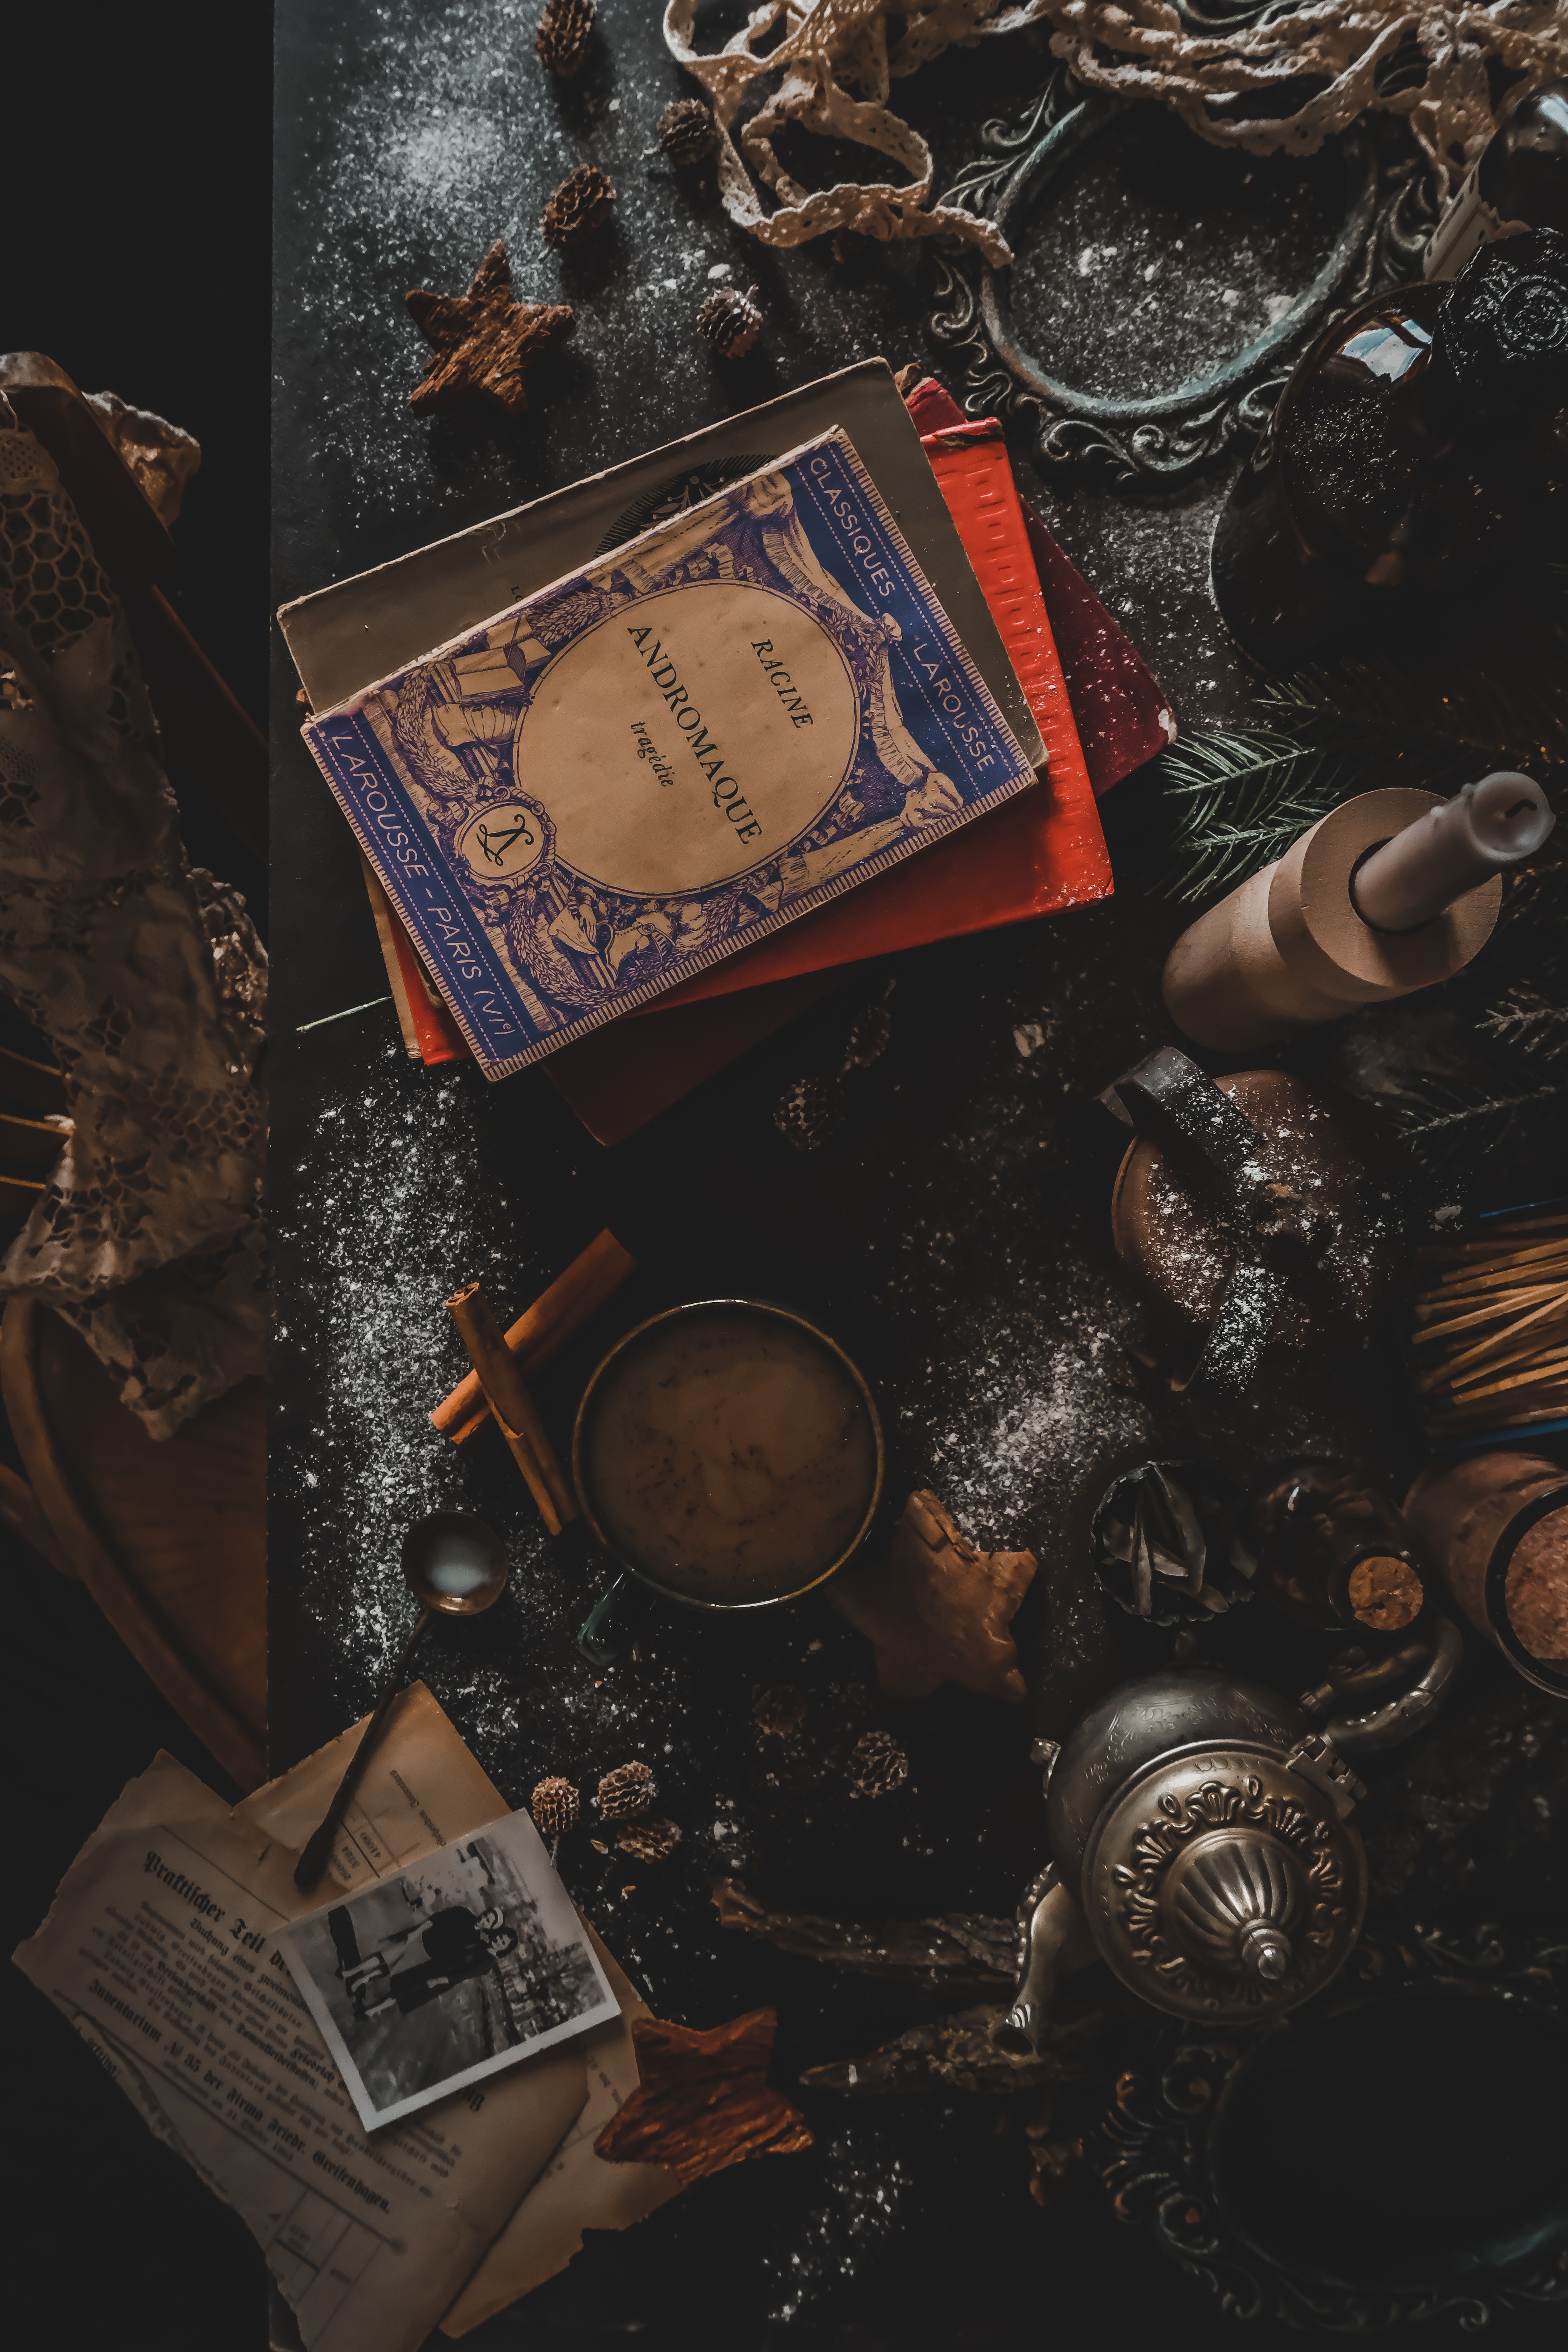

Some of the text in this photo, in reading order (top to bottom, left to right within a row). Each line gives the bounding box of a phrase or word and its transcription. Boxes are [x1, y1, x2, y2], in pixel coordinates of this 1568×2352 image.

[751, 638, 814, 728] RACINE
[810, 457, 995, 772] CLASSIQUES LAROUSSE
[627, 627, 762, 845] ANDROMAQUE
[630, 721, 674, 787] tragédie
[332, 735, 430, 879] LAROUSSE
[426, 907, 482, 979] PARIS
[190, 1917, 229, 1956] Buchung
[232, 1954, 256, 1974] eines
[229, 1918, 266, 1953] Teil
[89, 1979, 162, 2042] Inventarium
[203, 2069, 223, 2090] der
[226, 2087, 263, 2122] Firma
[268, 2118, 306, 2154] Friedr.
[312, 2151, 390, 2214] Greifenhagen.
